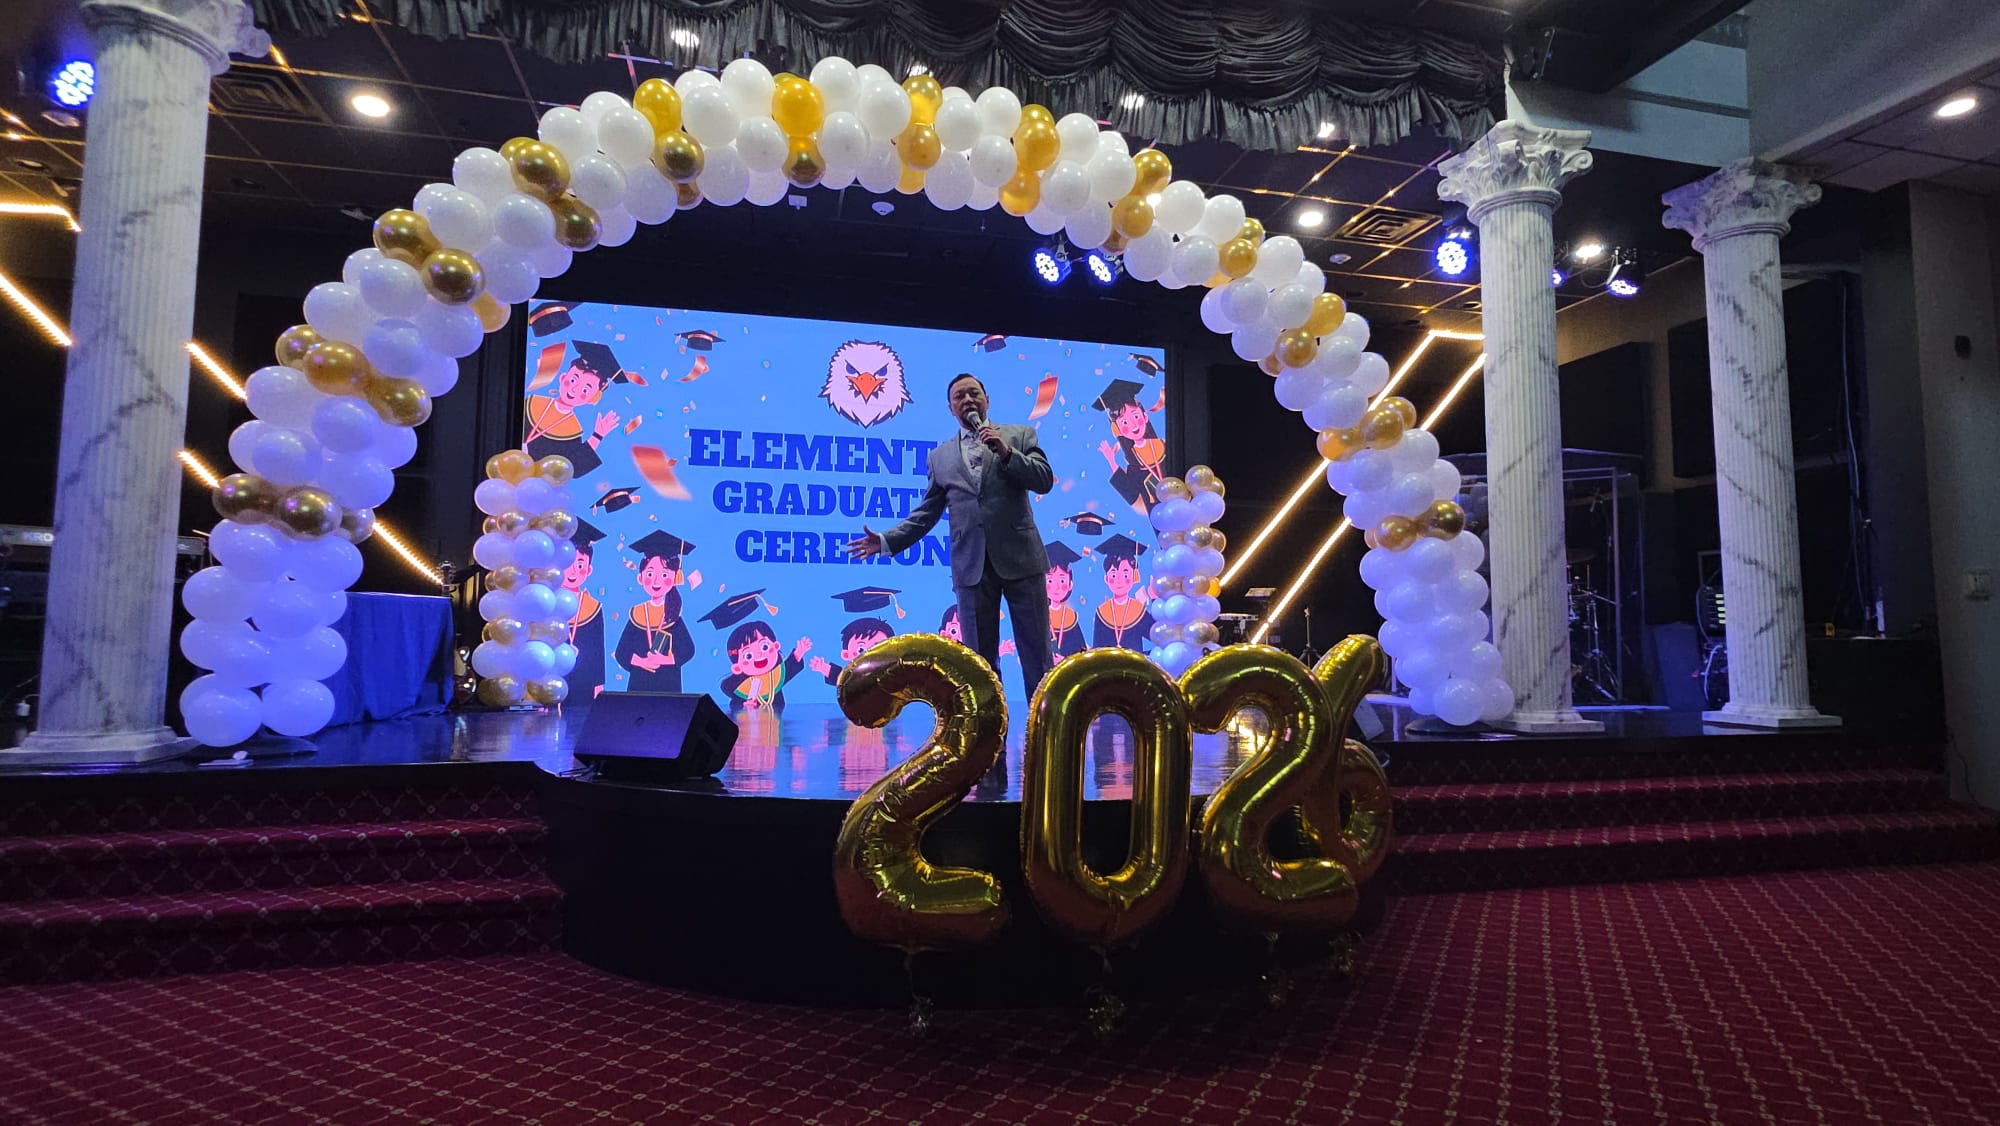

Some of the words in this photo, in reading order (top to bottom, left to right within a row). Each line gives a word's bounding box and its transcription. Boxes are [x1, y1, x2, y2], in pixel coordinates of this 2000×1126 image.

[688, 428, 937, 475] ELEMENT
[713, 480, 949, 520] GRADUAT
[735, 529, 951, 566] CEREON
